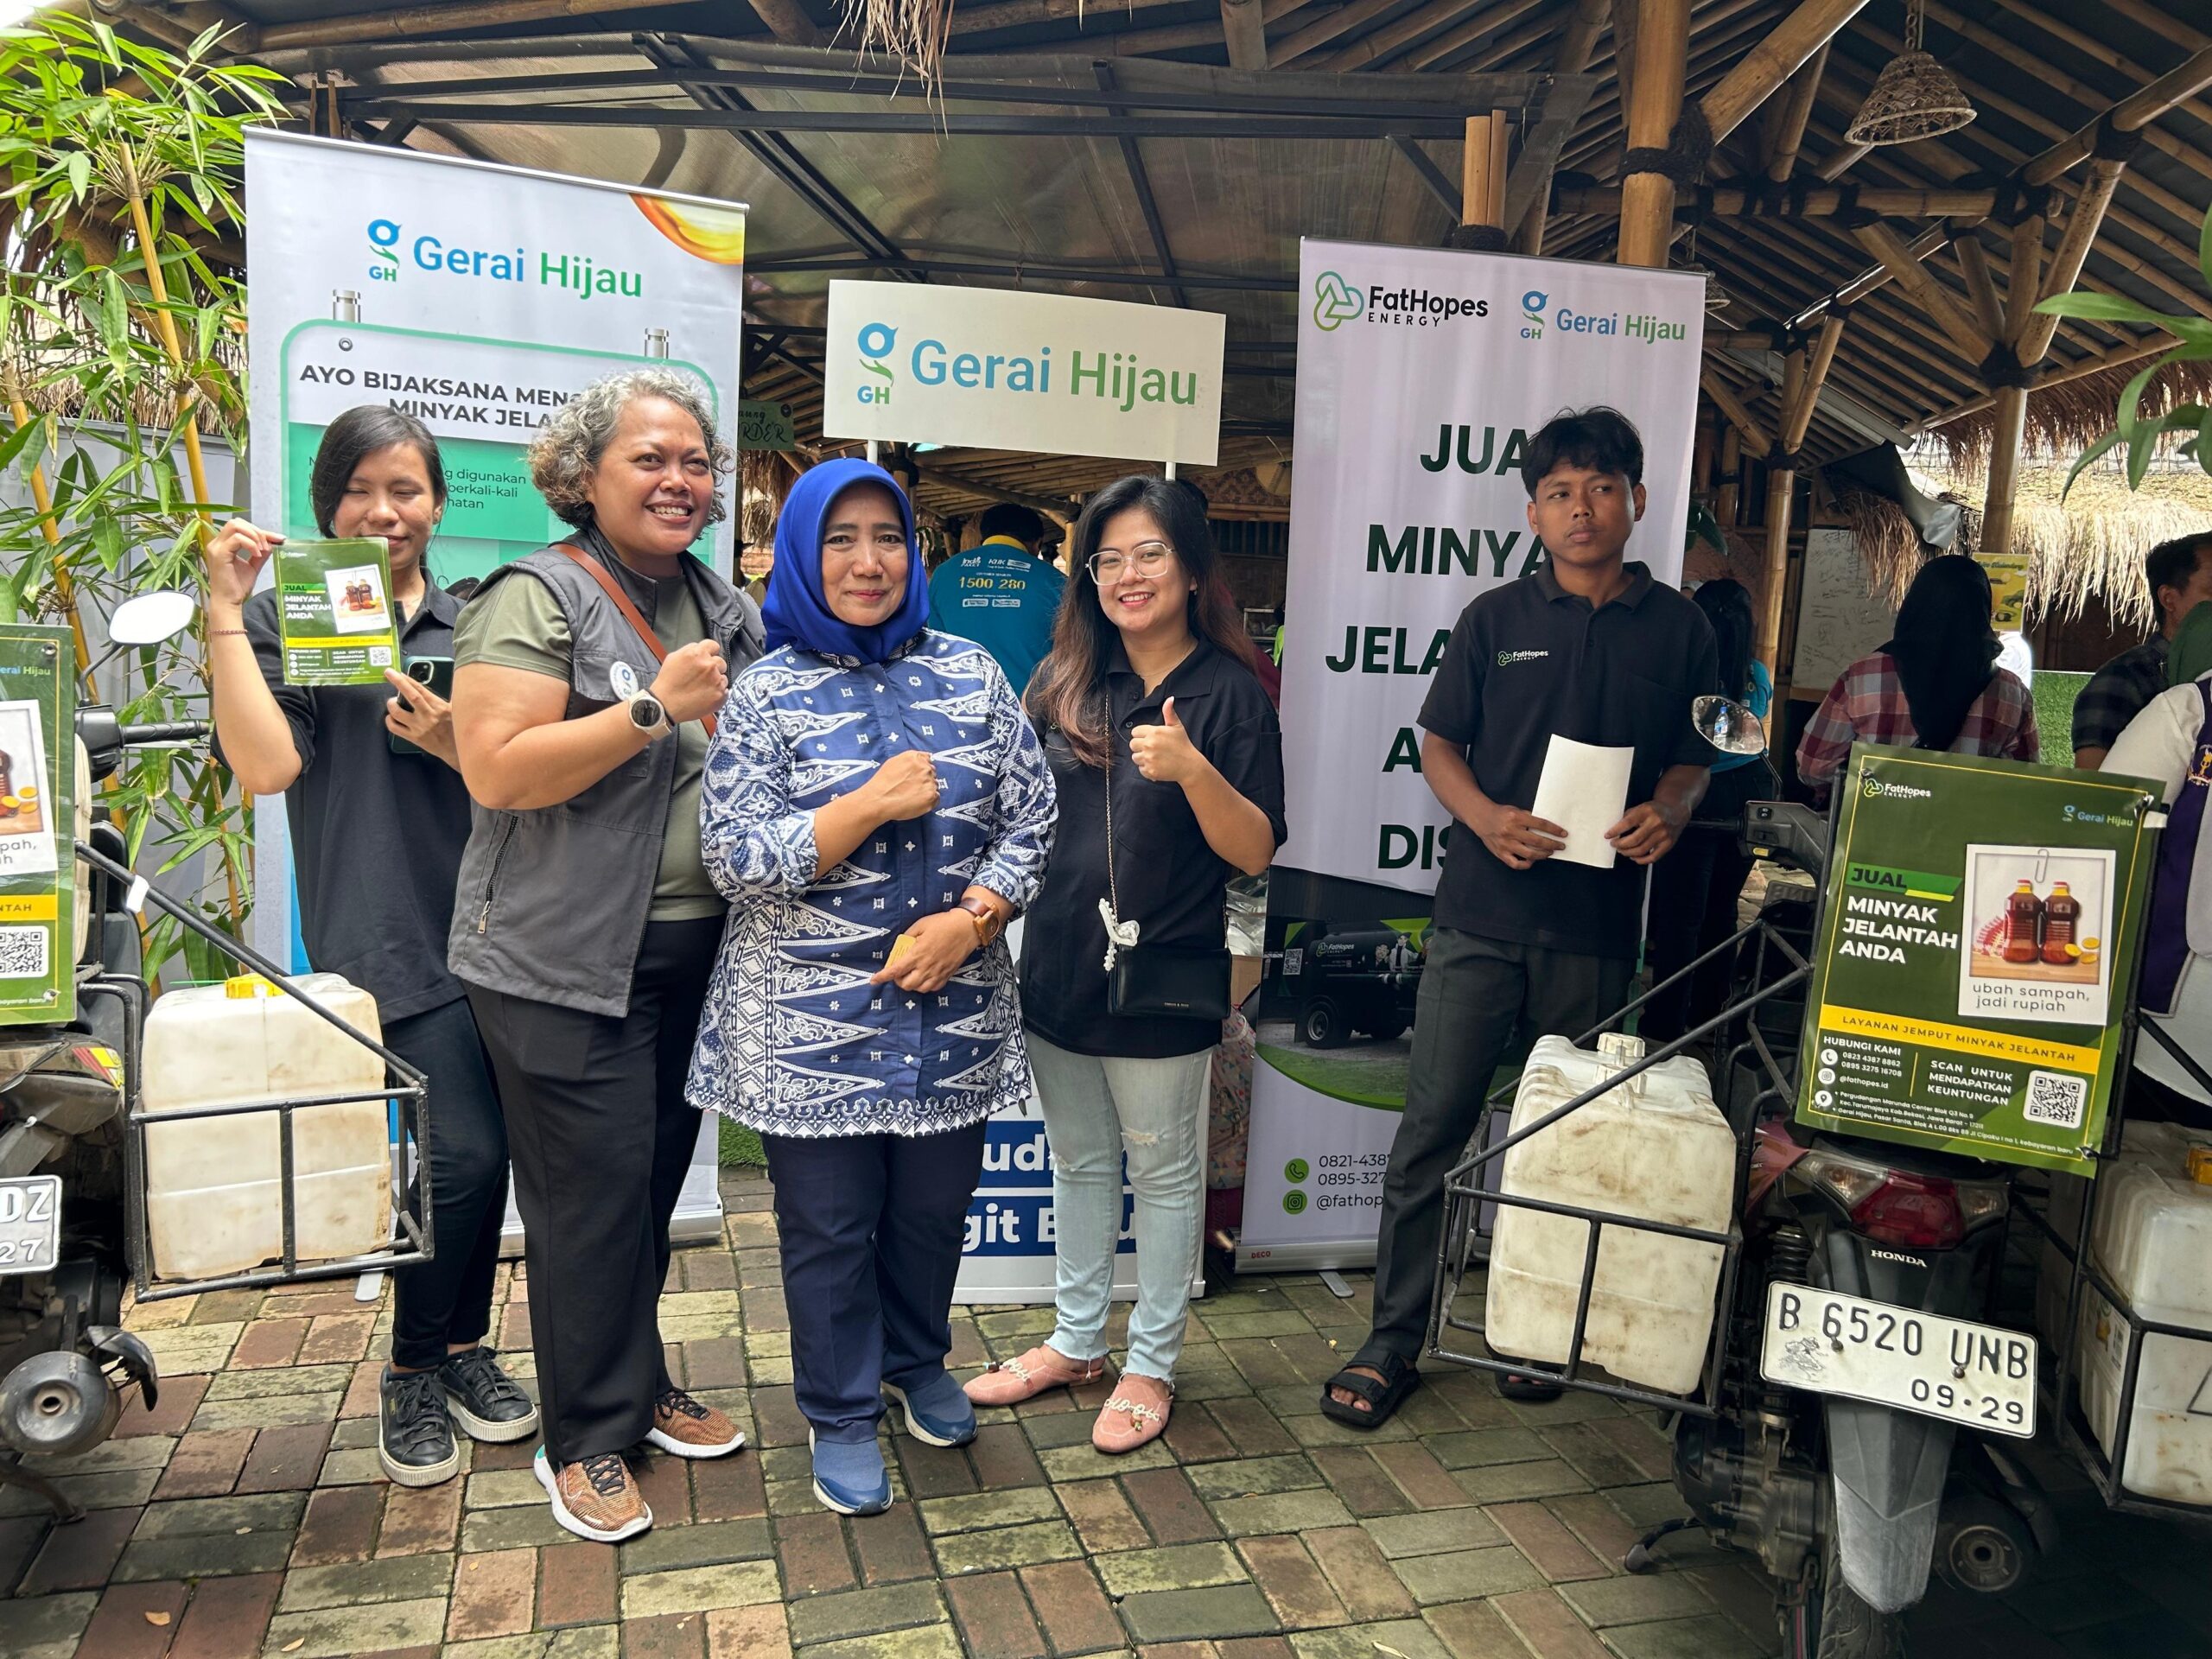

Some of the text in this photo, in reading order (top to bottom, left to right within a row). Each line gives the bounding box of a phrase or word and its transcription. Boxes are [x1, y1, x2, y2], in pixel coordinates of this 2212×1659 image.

[369, 266, 397, 282] GH
[413, 236, 641, 300] Gerai Hijau
[1369, 285, 1489, 321] FatHopes
[1368, 312, 1440, 327] ENERGY
[1556, 308, 1686, 345] Gerai Hijau
[1520, 327, 1542, 340] GH
[300, 365, 355, 386] AYO
[364, 371, 508, 402] BIJAKSANA
[912, 339, 1197, 412] Gerai Hijau
[857, 385, 890, 404] GH
[389, 398, 553, 429] MINYAK JELA
[738, 422, 788, 442] RDER
[1420, 424, 1529, 476] JUA
[456, 468, 526, 485] digunakan
[448, 481, 518, 499] berkali-kali
[447, 498, 484, 509] hatan
[1366, 524, 1548, 578] MINYA
[959, 576, 1026, 589] 1500 280
[284, 594, 322, 603] MINYAK
[1325, 626, 1452, 675] JELA
[22, 666, 51, 677] Hijau
[1382, 728, 1423, 773] A
[1885, 783, 1931, 798] FatHopes
[2077, 811, 2133, 827] Gerai Hijau
[1377, 824, 1452, 870] DIS
[1851, 868, 1907, 888] JUAL
[1847, 895, 1938, 924] MINYAK
[1842, 917, 1959, 949] JELANTAH
[1839, 940, 1906, 963] ANDA
[1973, 983, 2090, 1002] ubah sampah,
[1976, 995, 2066, 1013] jadi rupiah
[1823, 1036, 1901, 1056] HUBUNGI KAMI
[1842, 1016, 2075, 1061] LAYANAN JEMPUT MINYAK JELANTAH
[1930, 1060, 2013, 1082] SCAN UNTUK
[1839, 1075, 1889, 1089] @fathopes.id
[1929, 1072, 2012, 1094] MENDAPATKAN
[1927, 1084, 2009, 1106] KEUNTUNGAN
[1318, 1172, 1388, 1185] 0895-327
[1316, 1193, 1383, 1211] @fathop
[1871, 1249, 1928, 1268] HONDA
[1778, 1293, 2029, 1379] B 6520 UNB
